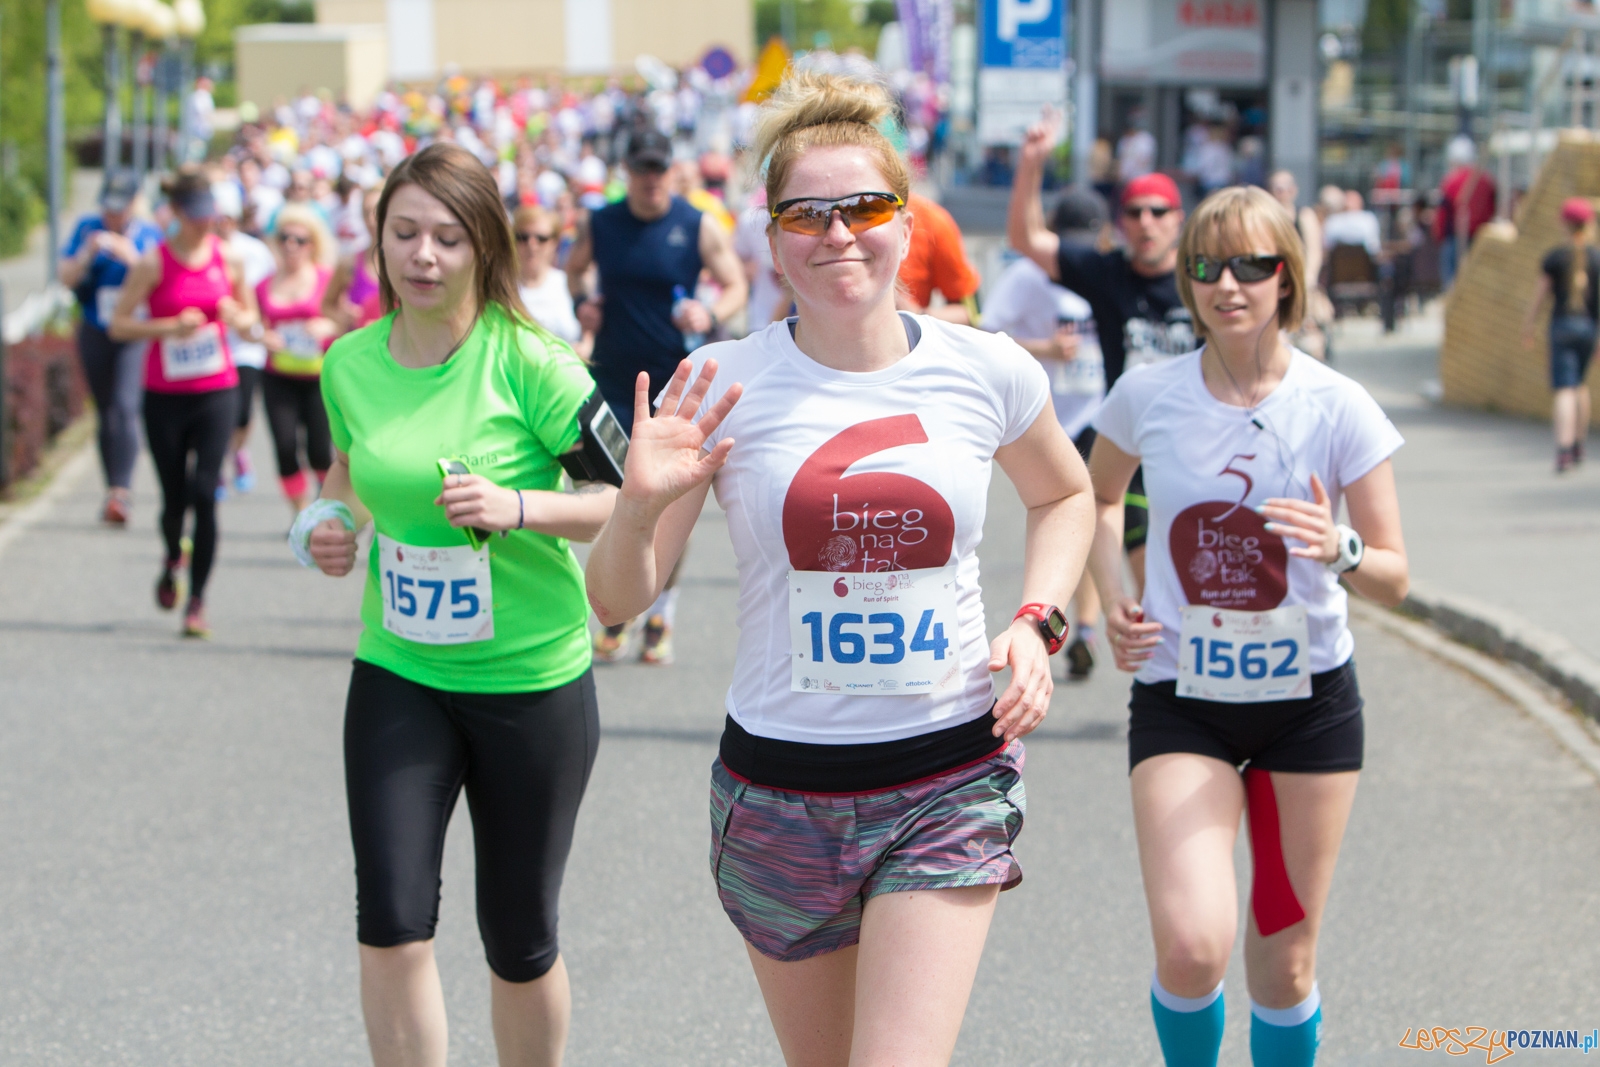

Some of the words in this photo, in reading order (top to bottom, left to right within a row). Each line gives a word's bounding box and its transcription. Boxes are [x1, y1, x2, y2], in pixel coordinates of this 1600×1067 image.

[997, 0, 1053, 41] P
[1211, 453, 1258, 523] 5
[831, 493, 928, 545] bieg
[860, 534, 894, 549] na
[861, 551, 907, 573] tak
[1198, 518, 1263, 565] bieg
[833, 576, 849, 598] 6
[853, 576, 885, 596] bieg
[899, 580, 915, 590] tak
[1220, 564, 1258, 584] tak
[386, 570, 480, 620] 1575
[883, 595, 899, 603] Spirit
[802, 609, 949, 665] 1634
[1190, 636, 1299, 680] 1562
